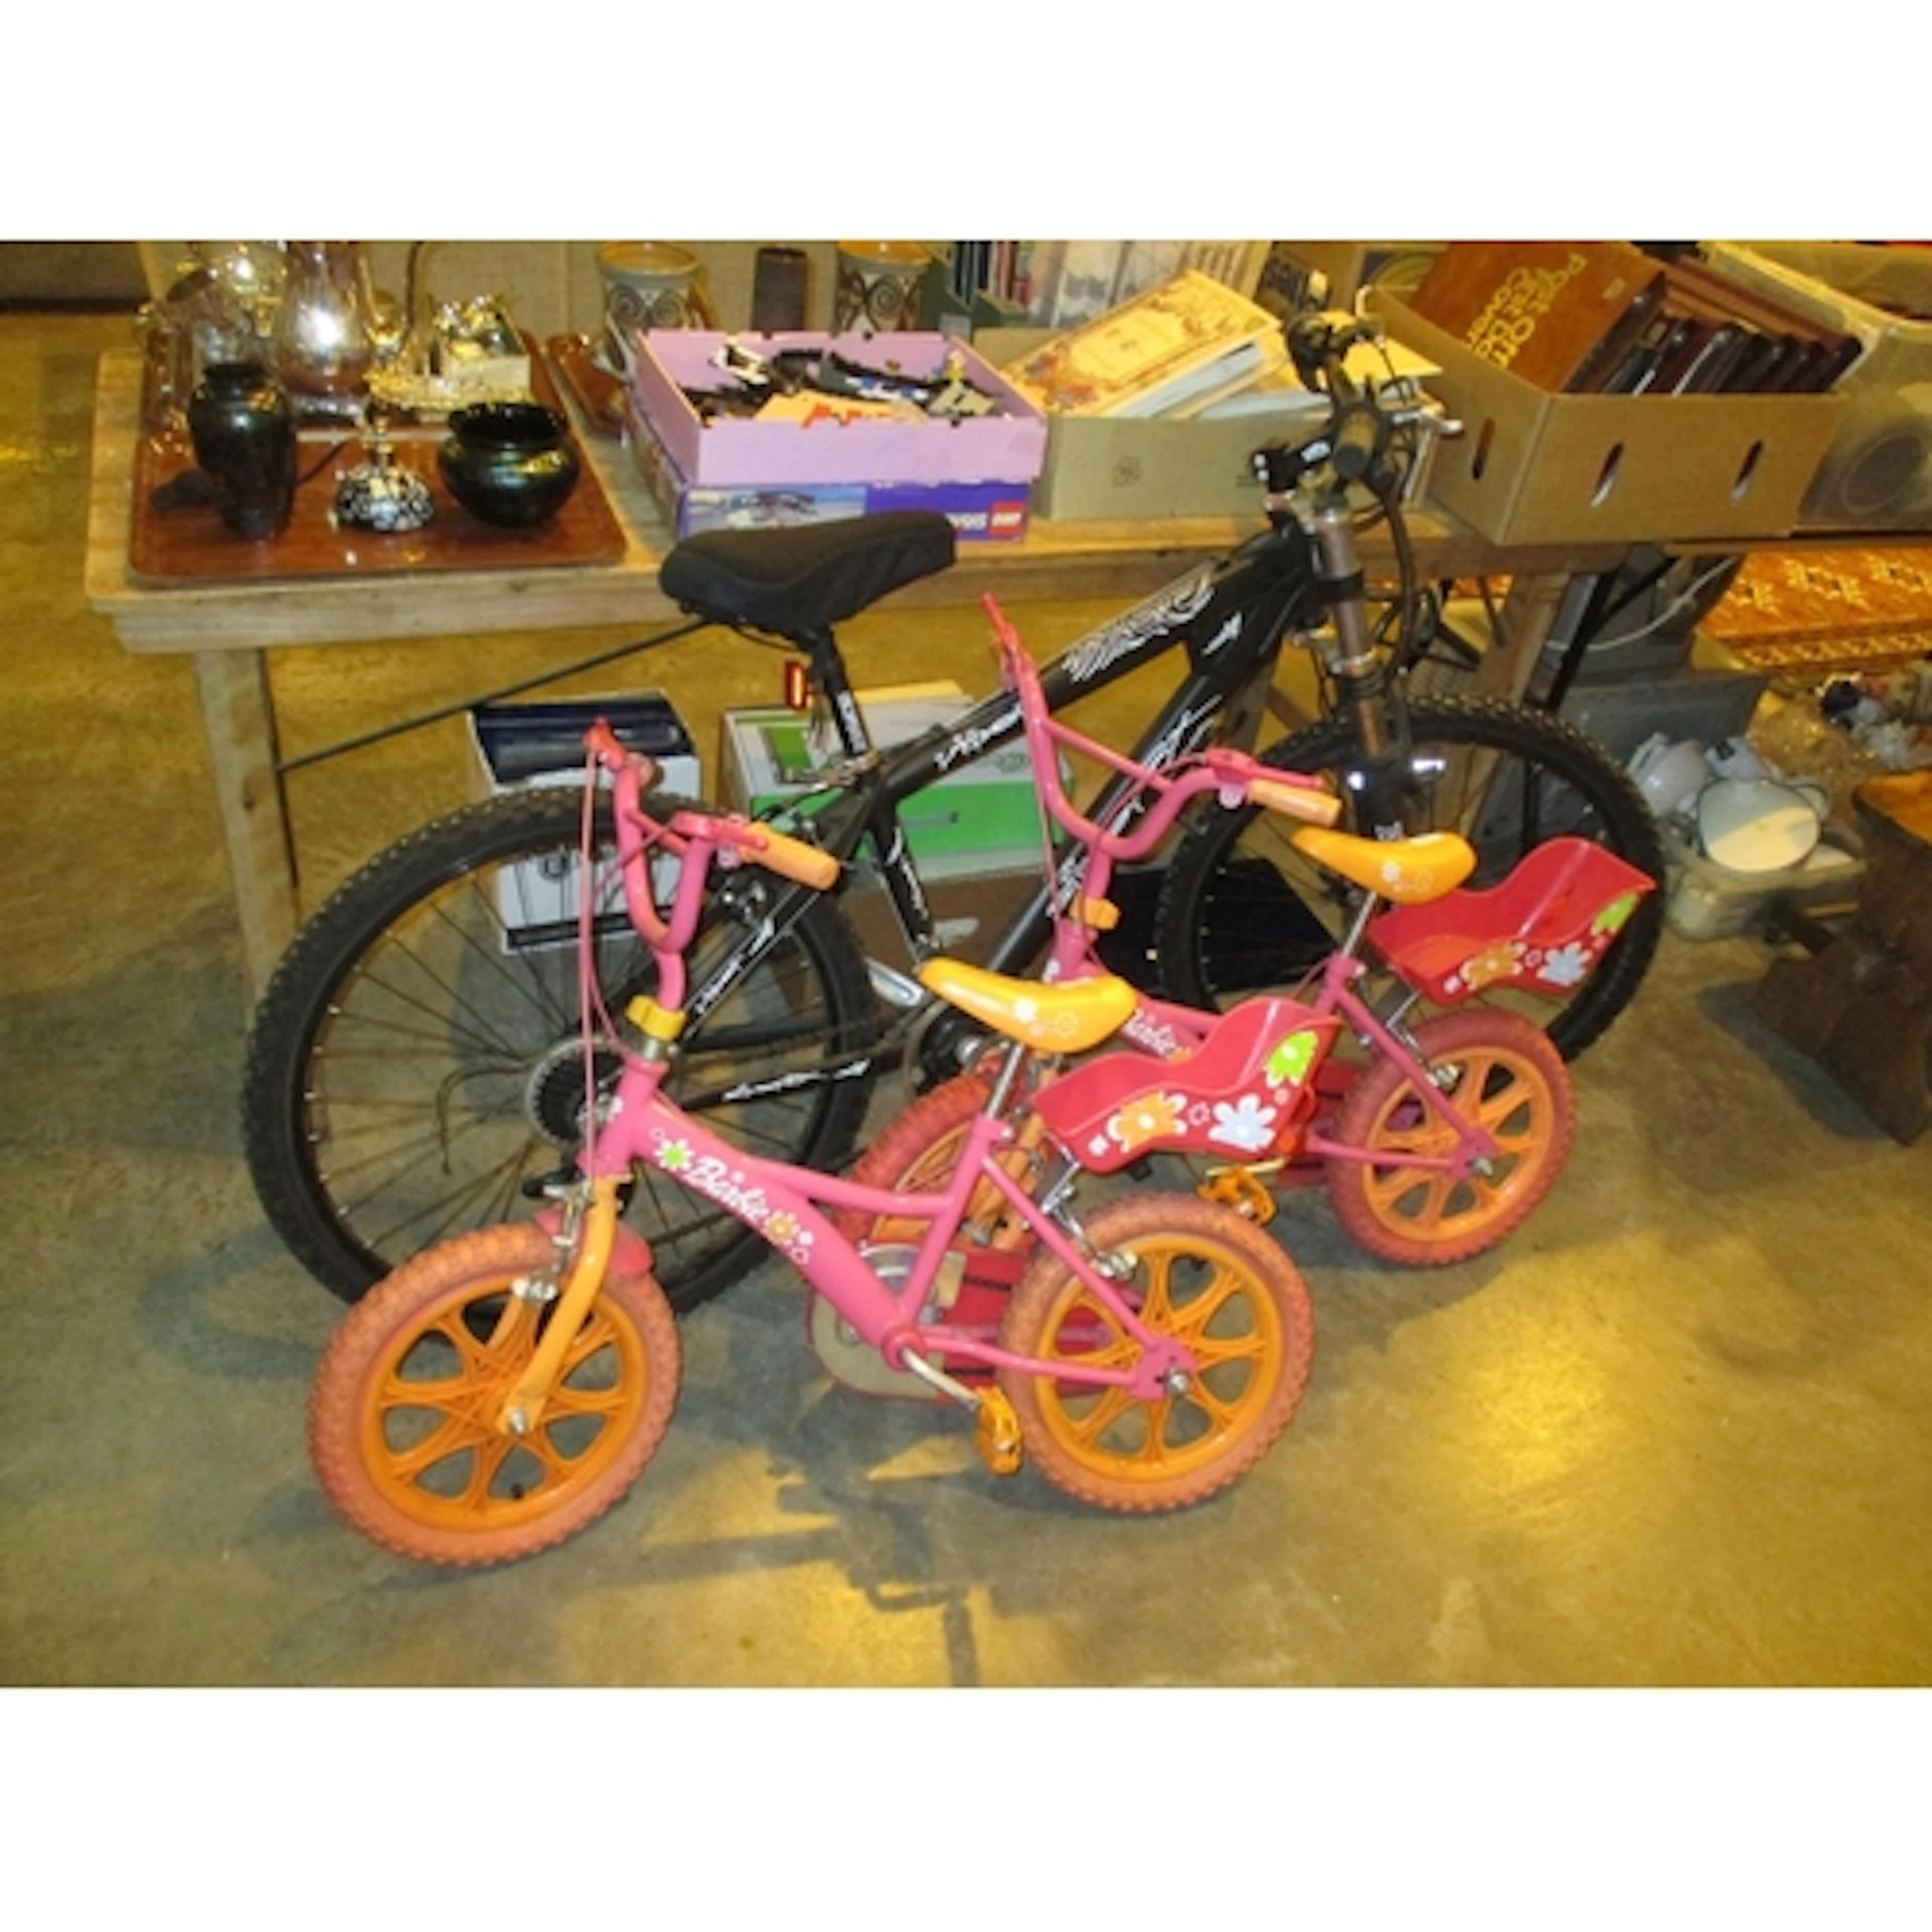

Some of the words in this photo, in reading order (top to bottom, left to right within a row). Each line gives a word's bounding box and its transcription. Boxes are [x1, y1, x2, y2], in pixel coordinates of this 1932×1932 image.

[1532, 252, 1588, 314] Post
[1472, 319, 1512, 359] Da
[1490, 315, 1536, 370] Off
[683, 1155, 770, 1225] Barbie
